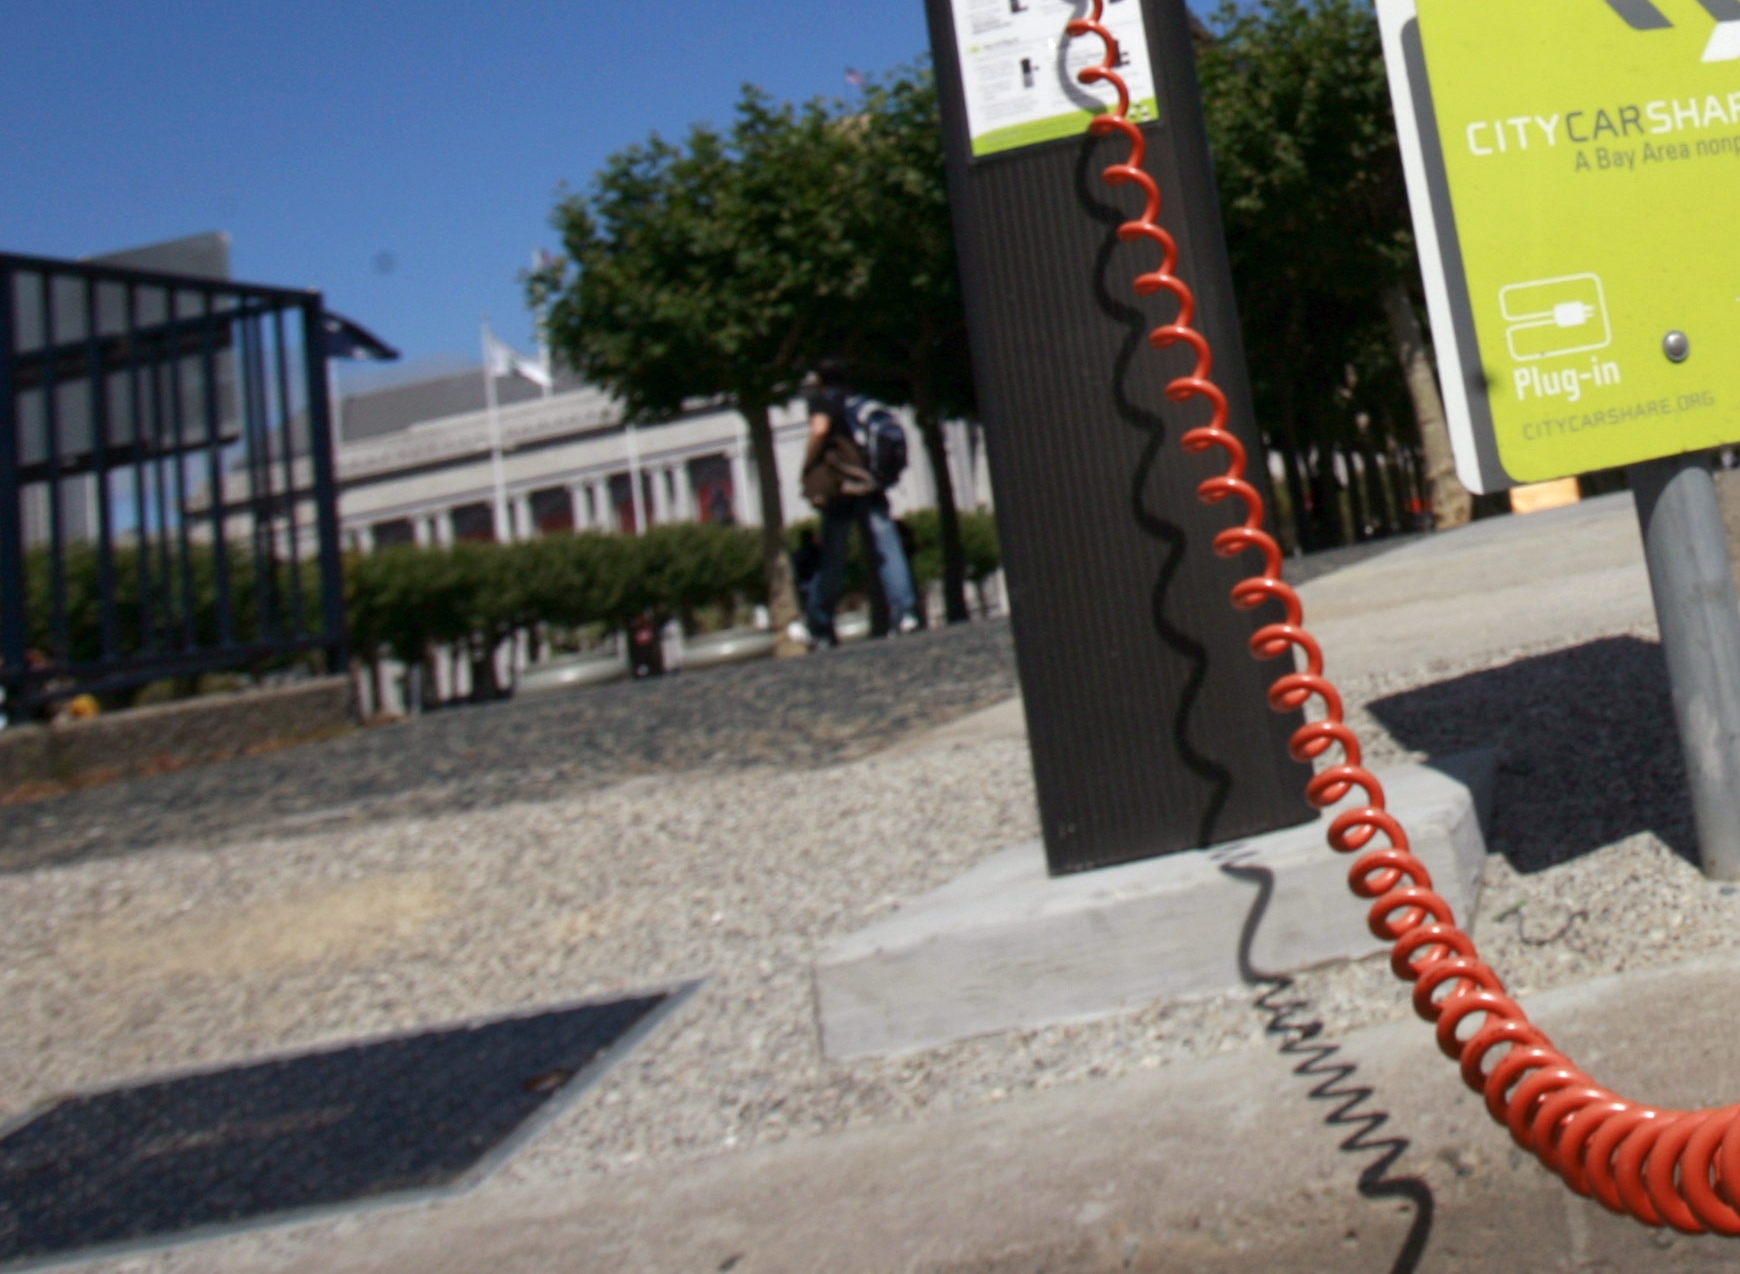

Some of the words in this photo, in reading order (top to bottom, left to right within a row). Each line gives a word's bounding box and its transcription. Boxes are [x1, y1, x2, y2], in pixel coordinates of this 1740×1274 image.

[1575, 150, 1591, 173] A
[1595, 146, 1636, 171] Bay
[1642, 141, 1691, 165] Area
[1514, 356, 1621, 403] Plug-in
[1522, 390, 1716, 441] CITYCARSHARE.ORG
